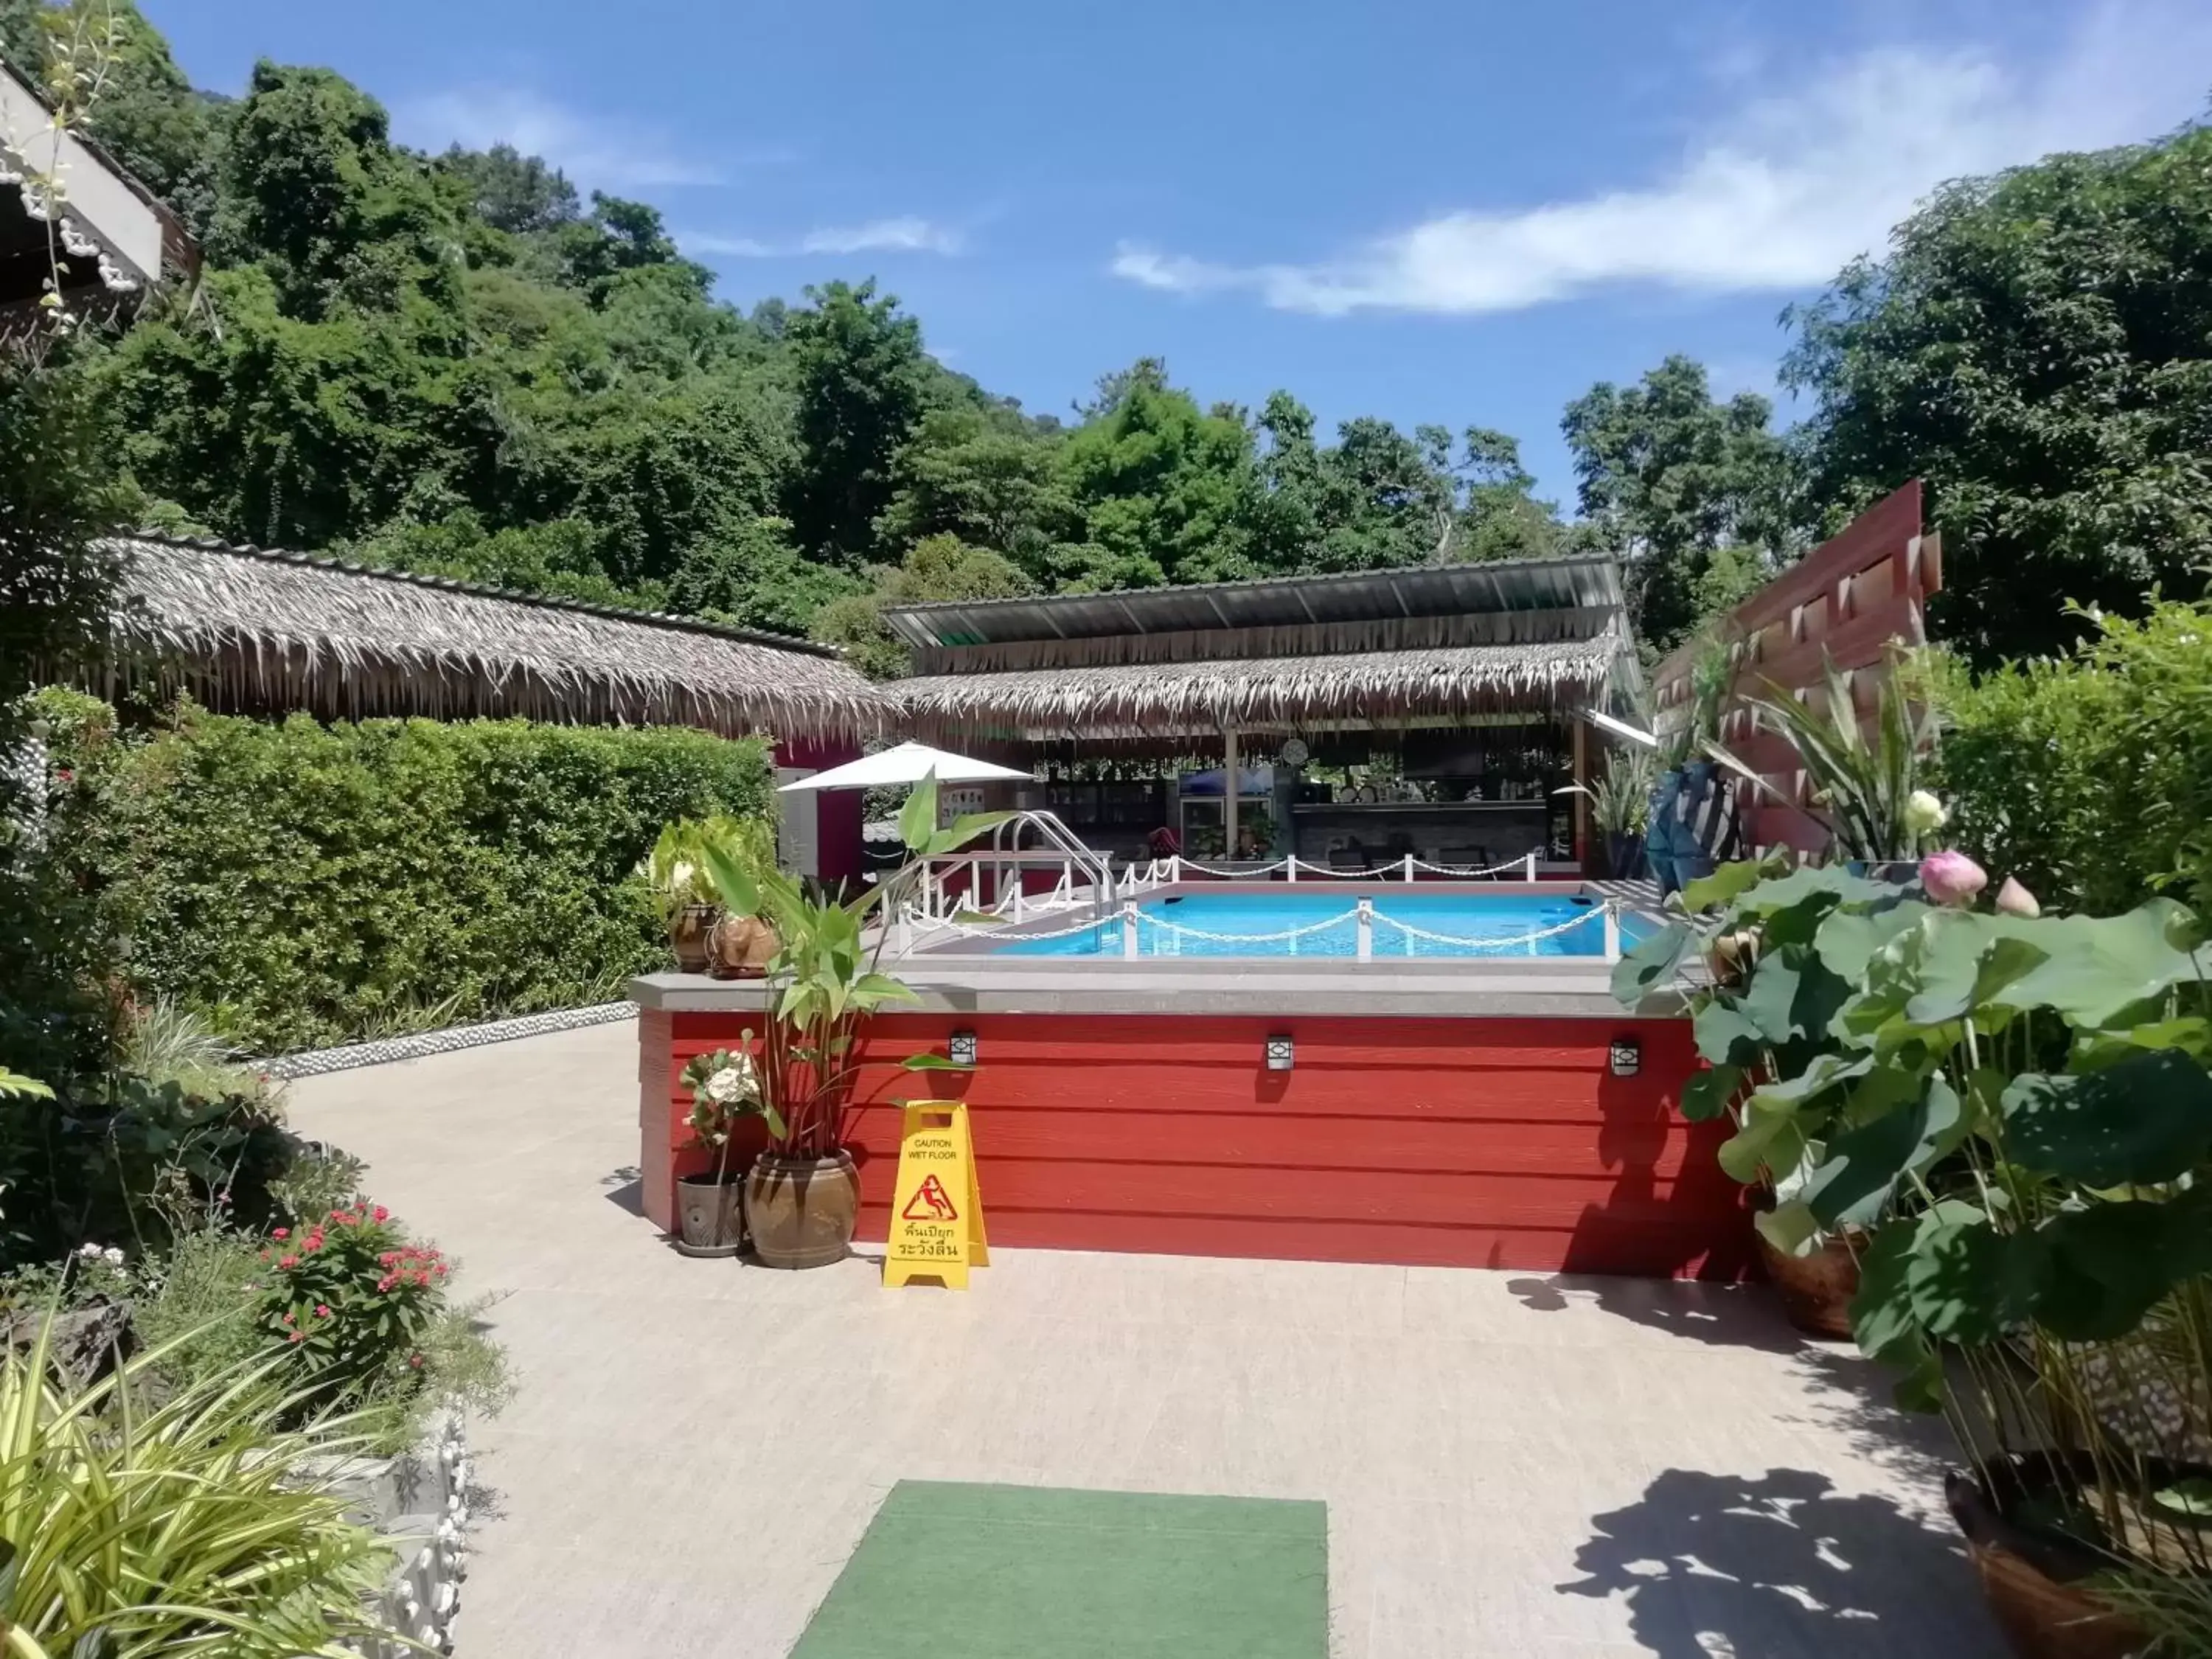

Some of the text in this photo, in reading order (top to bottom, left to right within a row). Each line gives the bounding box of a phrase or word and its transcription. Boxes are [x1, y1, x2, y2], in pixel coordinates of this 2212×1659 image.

[914, 1139, 952, 1147] CAUTION
[908, 1151, 956, 1159] WET FLOOR
